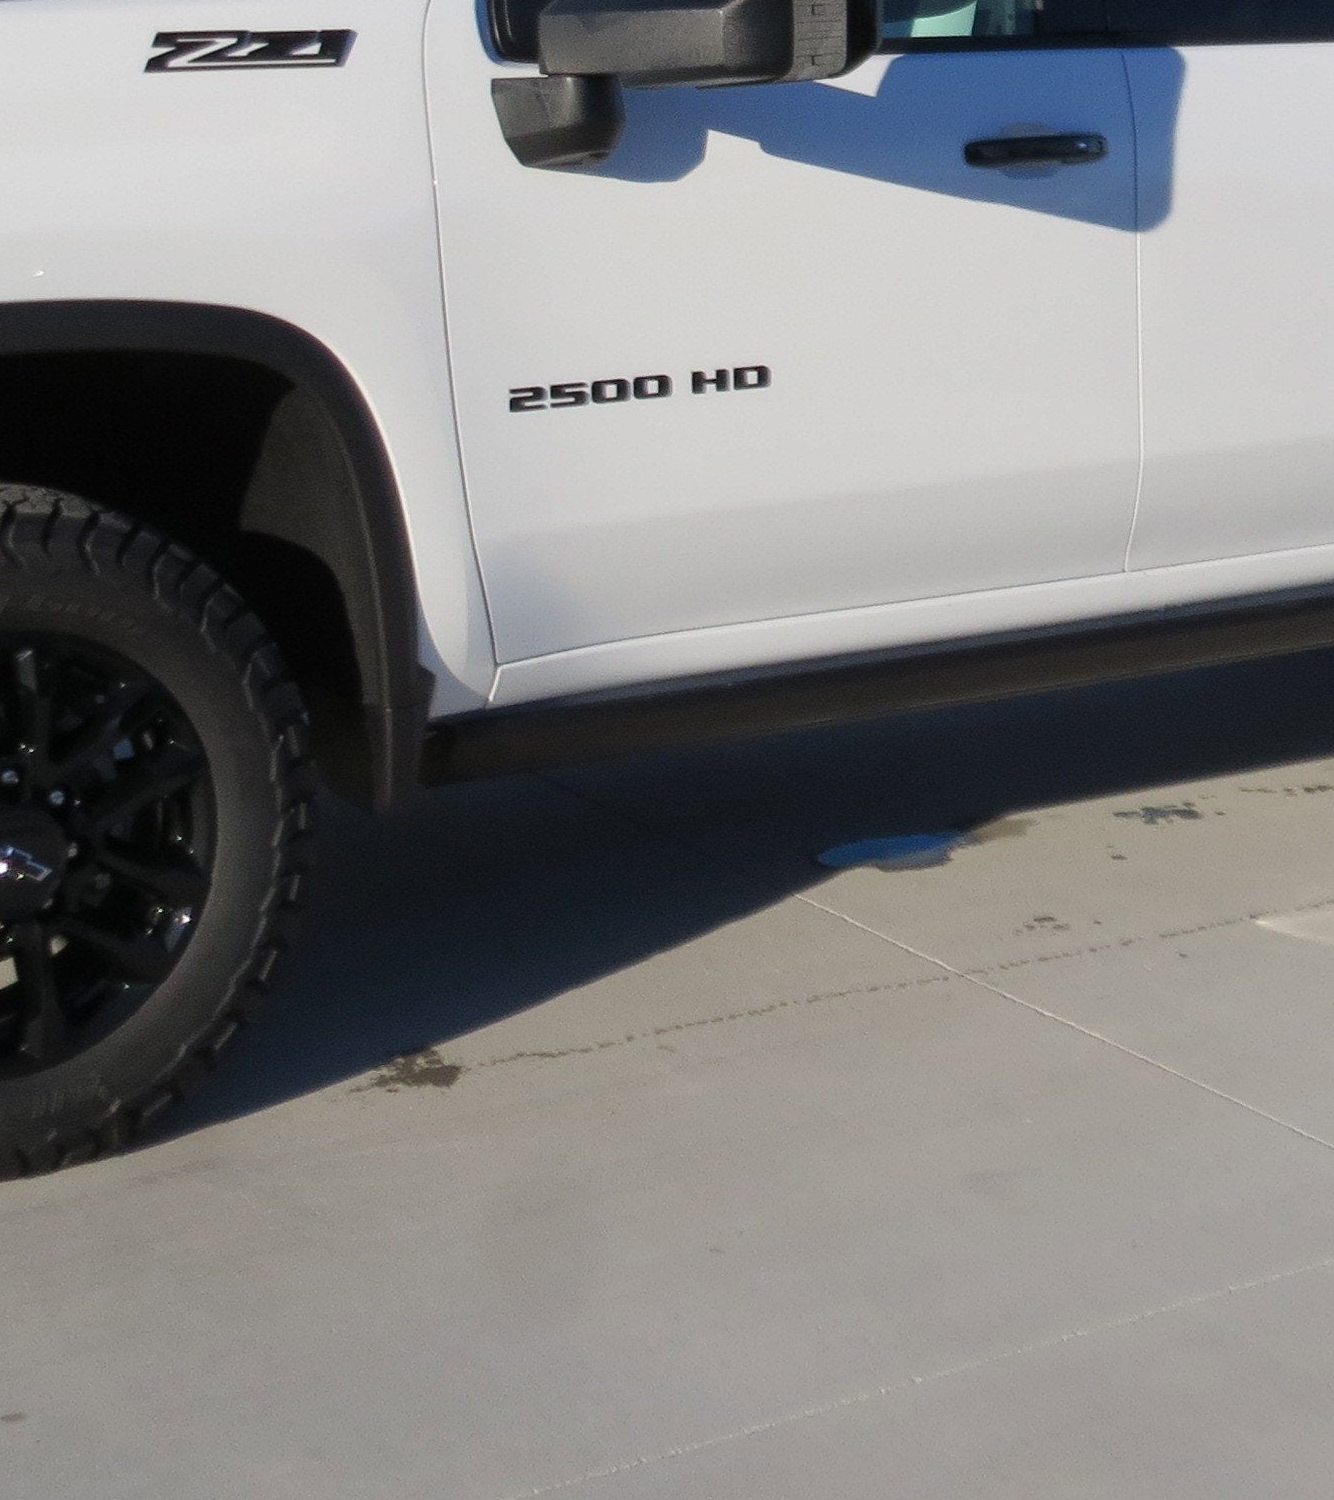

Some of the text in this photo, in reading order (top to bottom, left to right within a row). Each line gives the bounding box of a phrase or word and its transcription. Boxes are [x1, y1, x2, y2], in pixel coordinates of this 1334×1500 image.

[144, 28, 357, 74] Z71
[508, 363, 773, 414] 2500 HD
